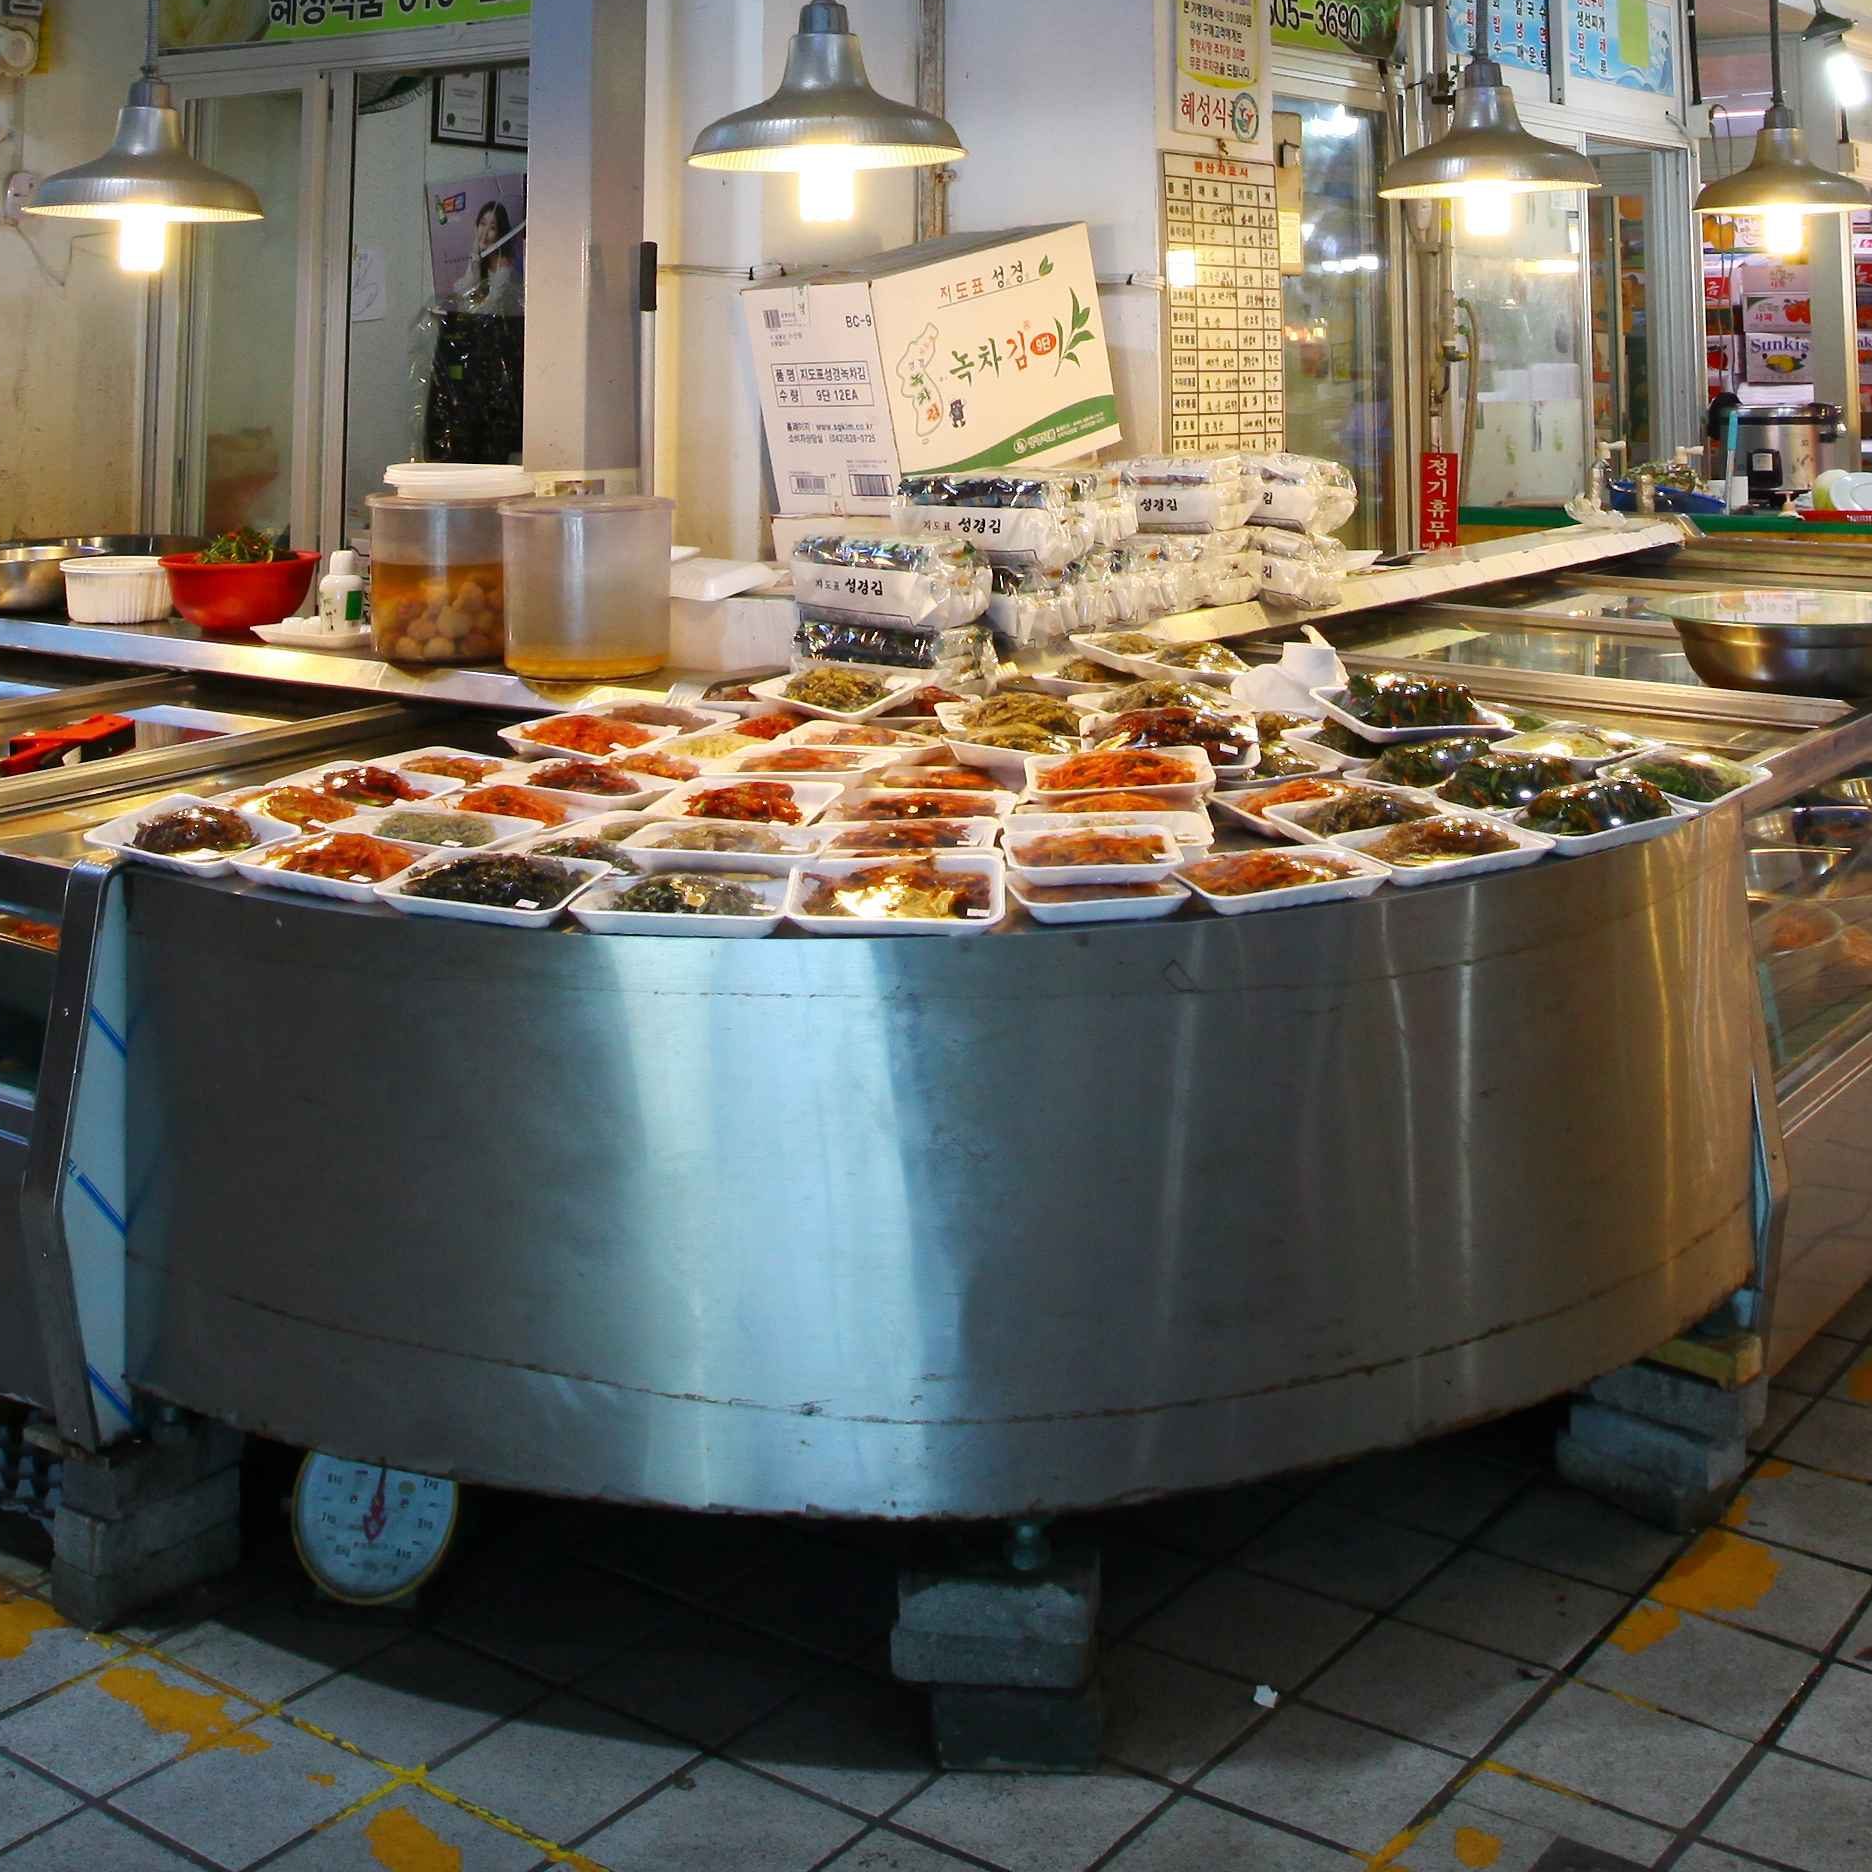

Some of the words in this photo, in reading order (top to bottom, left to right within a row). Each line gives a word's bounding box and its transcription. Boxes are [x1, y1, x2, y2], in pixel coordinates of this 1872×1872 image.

[939, 276, 985, 304] 지도표
[992, 259, 1024, 289] 성경
[845, 314, 873, 329] BC-9
[1750, 335, 1811, 354] Sunkis
[948, 330, 1029, 388] 녹차김
[799, 366, 867, 382] 지도표성경녹차김
[834, 389, 859, 402] 12EA
[1139, 497, 1179, 513] 성경김
[1426, 456, 1451, 540] 정기휴무
[958, 517, 1003, 535] 성경김
[844, 577, 884, 597] 성경김
